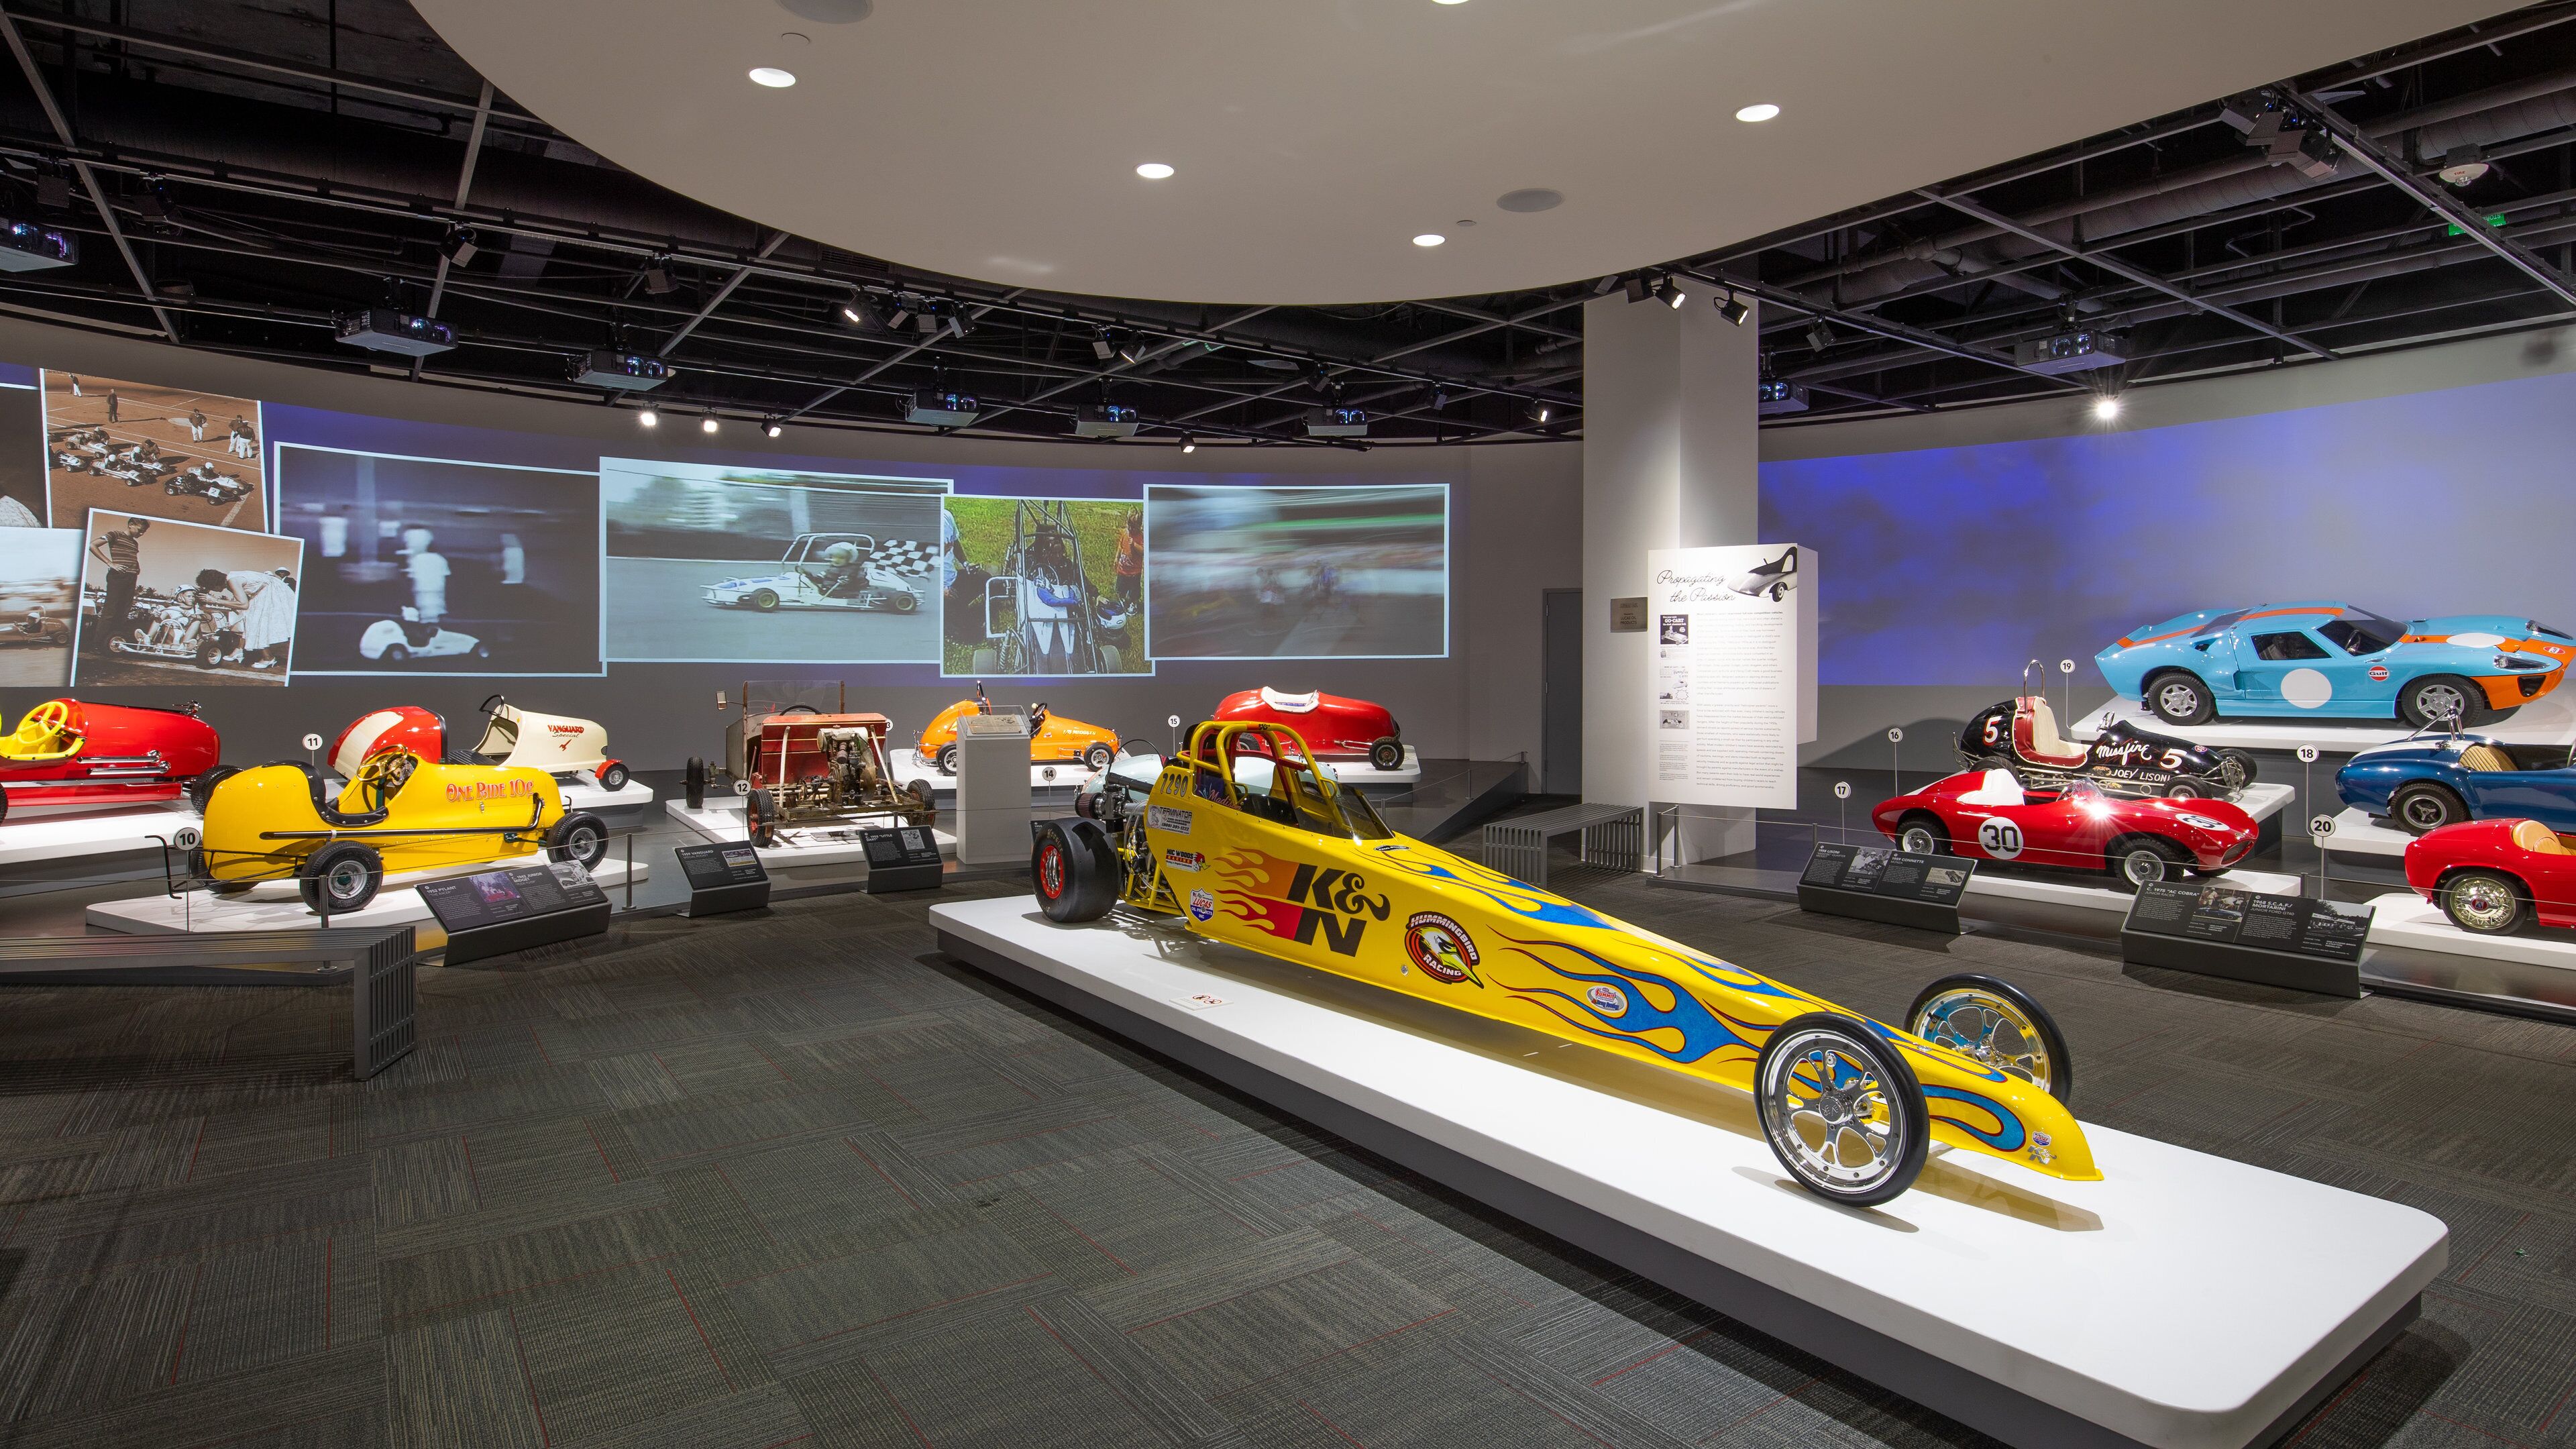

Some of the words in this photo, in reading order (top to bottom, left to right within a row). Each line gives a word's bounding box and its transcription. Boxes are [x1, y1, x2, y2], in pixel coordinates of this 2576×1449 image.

[1656, 570, 1726, 588] Propagating
[1670, 590, 1687, 602] the
[1690, 587, 1736, 602] Passion
[547, 724, 584, 734] VANGUARD
[1984, 716, 2002, 746] 5
[307, 737, 318, 746] 11
[2159, 749, 2188, 769] 5
[2300, 749, 2314, 758] 18
[2111, 768, 2139, 779] JOEY
[2139, 771, 2171, 782] LISONI
[737, 784, 747, 792] 12
[1837, 786, 1846, 795] 17
[1160, 807, 1192, 820] TERMINATOR
[2314, 820, 2331, 832] 20
[179, 833, 196, 845] 10
[1982, 824, 2019, 853] 30
[1176, 850, 1193, 859] WOODS
[1193, 898, 1212, 908] LUCAS
[2252, 903, 2286, 911] MORTARINI
[1411, 914, 1478, 961] HUMMINGBIRD
[1423, 953, 1461, 976] RACING
